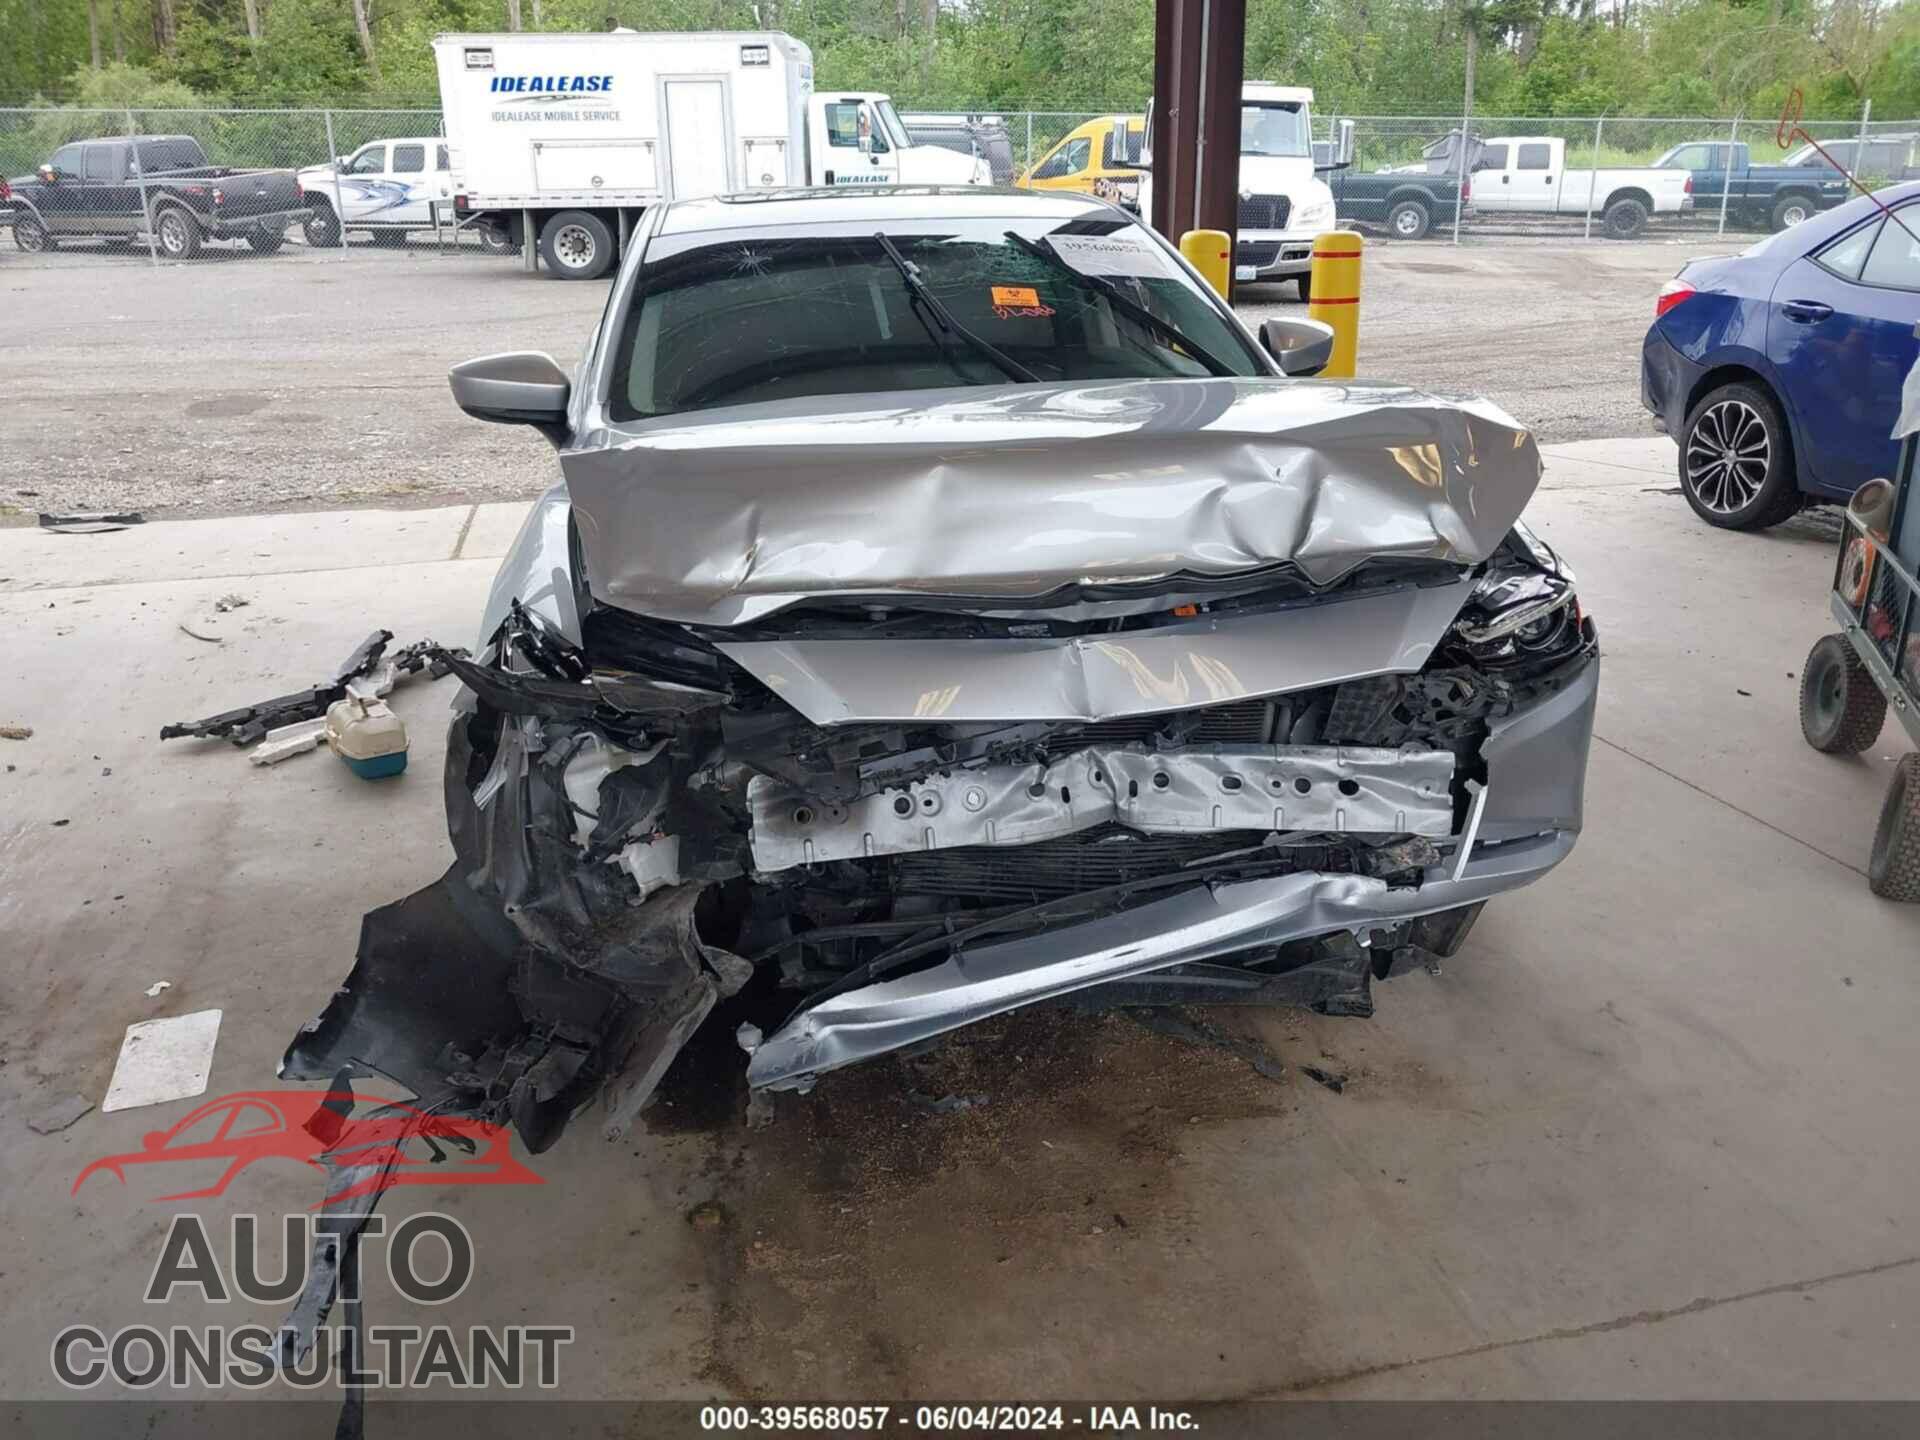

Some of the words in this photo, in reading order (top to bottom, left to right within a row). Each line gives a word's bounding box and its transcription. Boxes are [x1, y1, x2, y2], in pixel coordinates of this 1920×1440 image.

[490, 75, 614, 92] IDEALEASE
[491, 111, 542, 122] IDEALEASE
[543, 111, 581, 122] MOBILE
[582, 110, 620, 122] SERVICE
[836, 175, 889, 183] IDEALEASE
